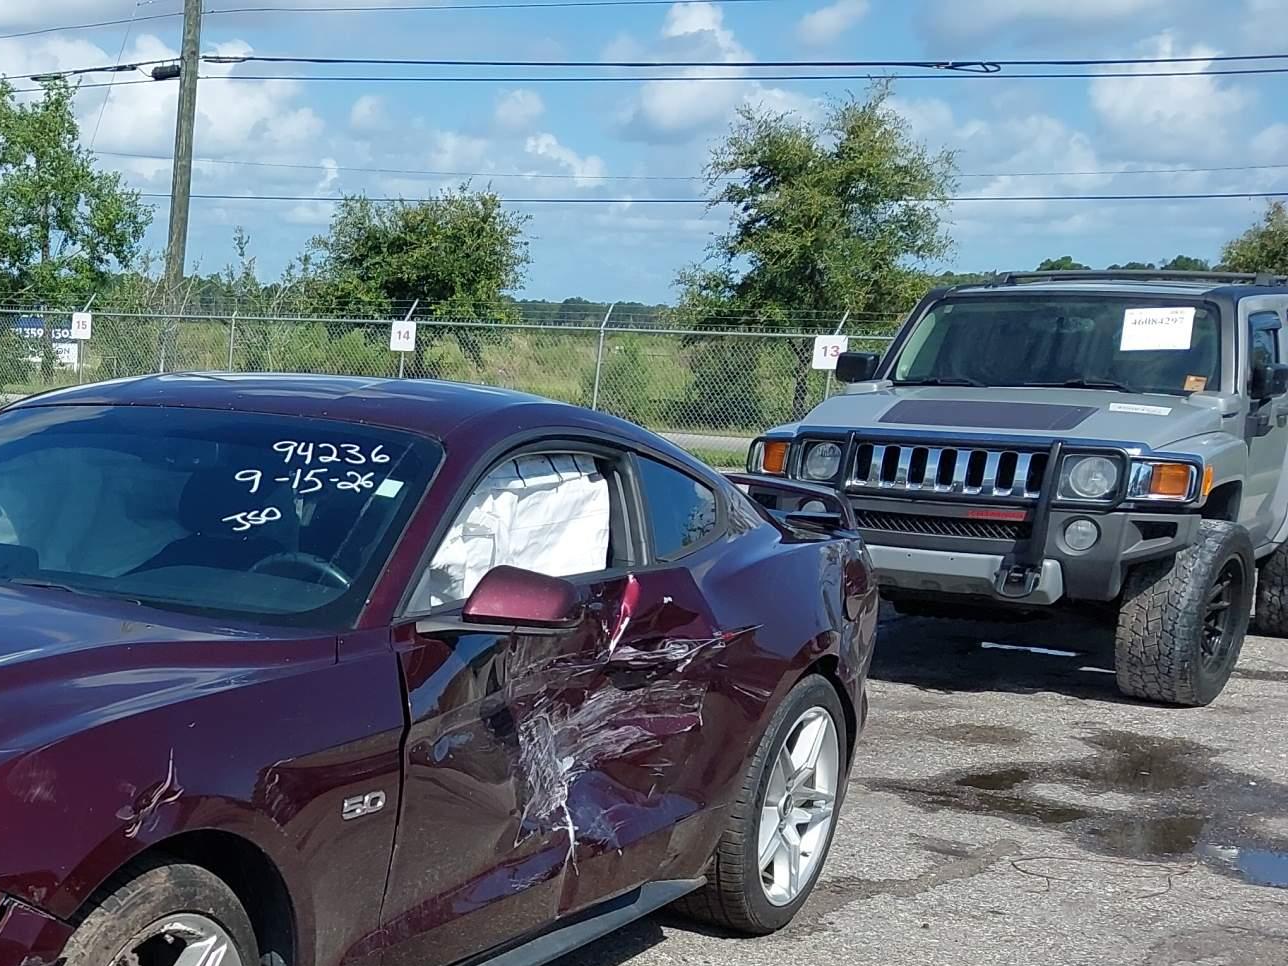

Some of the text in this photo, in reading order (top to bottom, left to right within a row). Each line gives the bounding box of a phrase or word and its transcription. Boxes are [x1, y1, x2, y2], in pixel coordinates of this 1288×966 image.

[76, 321, 87, 330] 15
[396, 330, 410, 341] 14
[822, 345, 840, 357] 13
[272, 440, 391, 465] 94236
